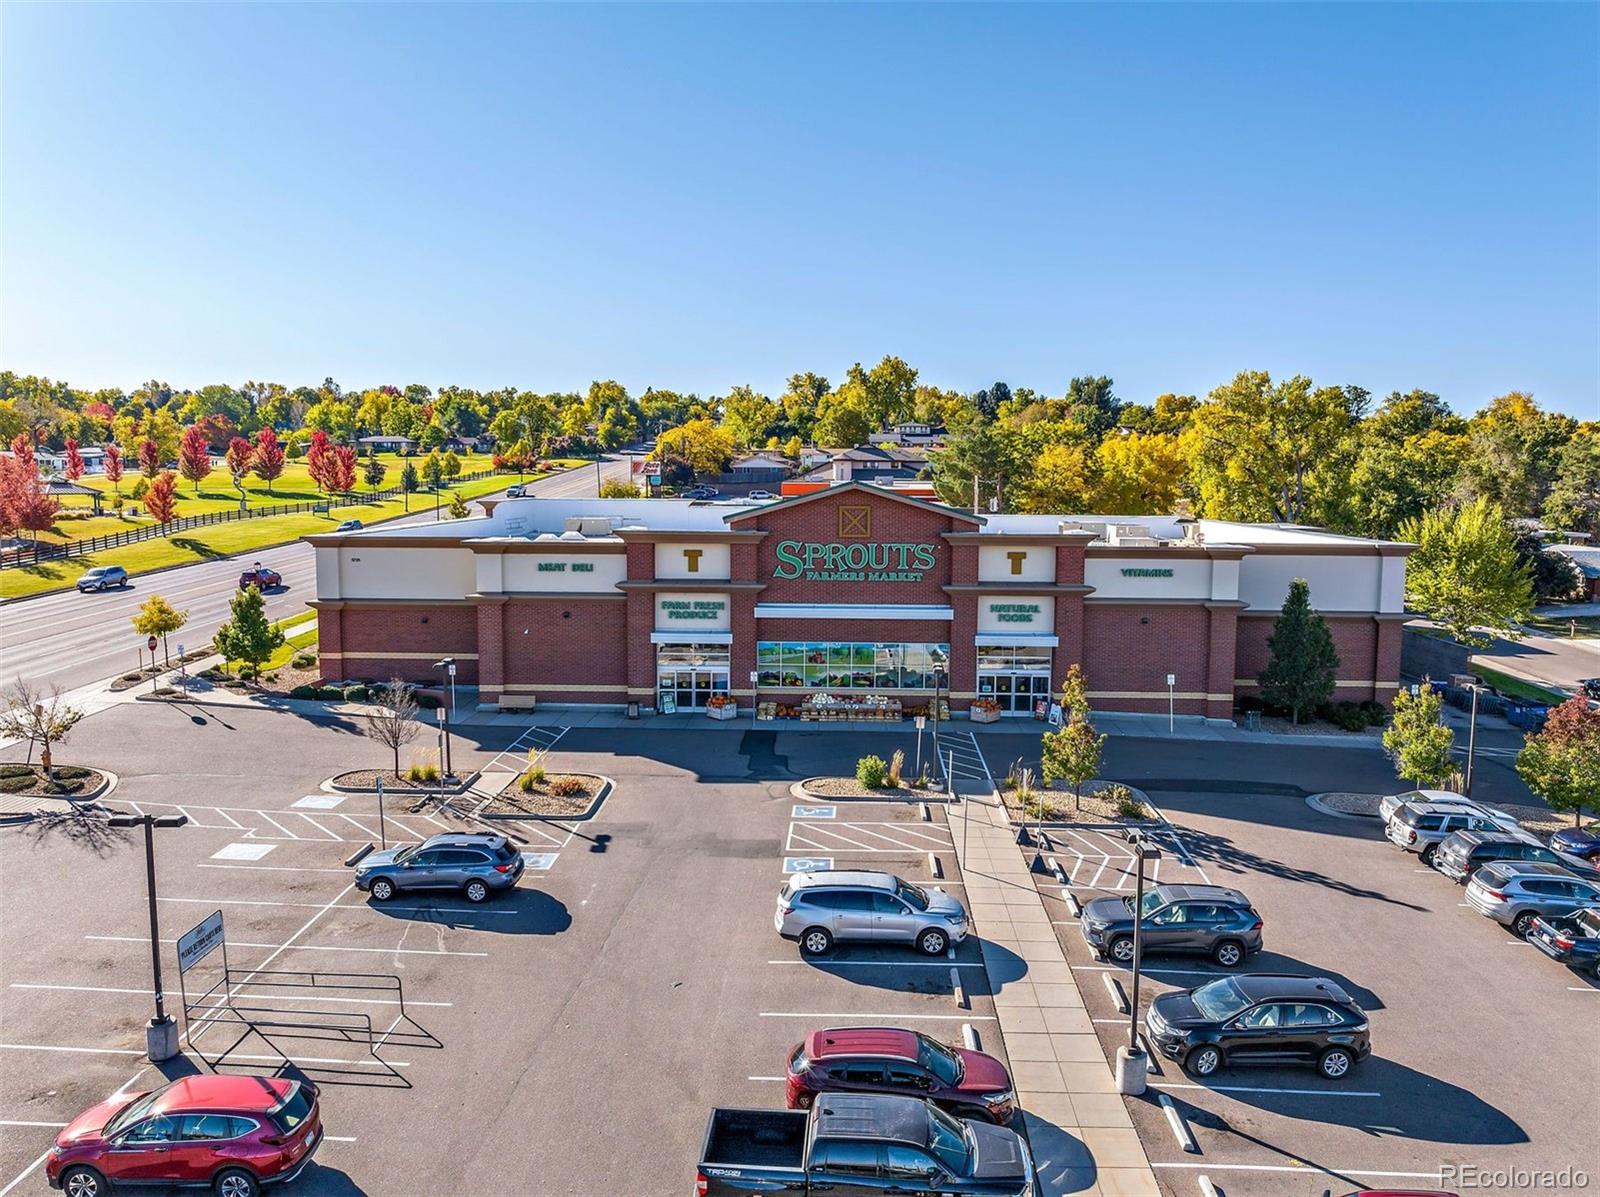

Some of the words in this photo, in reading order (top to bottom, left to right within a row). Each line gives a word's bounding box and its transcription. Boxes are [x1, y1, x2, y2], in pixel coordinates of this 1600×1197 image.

[773, 540, 936, 580] SPROUTS
[537, 562, 567, 572] MEAT
[571, 563, 594, 572] DELI
[806, 571, 865, 581] FARMERS
[868, 571, 924, 582] MARKET
[1120, 568, 1174, 578] VITAMINS
[661, 601, 691, 610] FARM
[693, 601, 725, 611] FRESH
[990, 604, 1041, 613] NATURAL
[668, 610, 719, 620] PRODUCE
[997, 613, 1033, 622] FOODS
